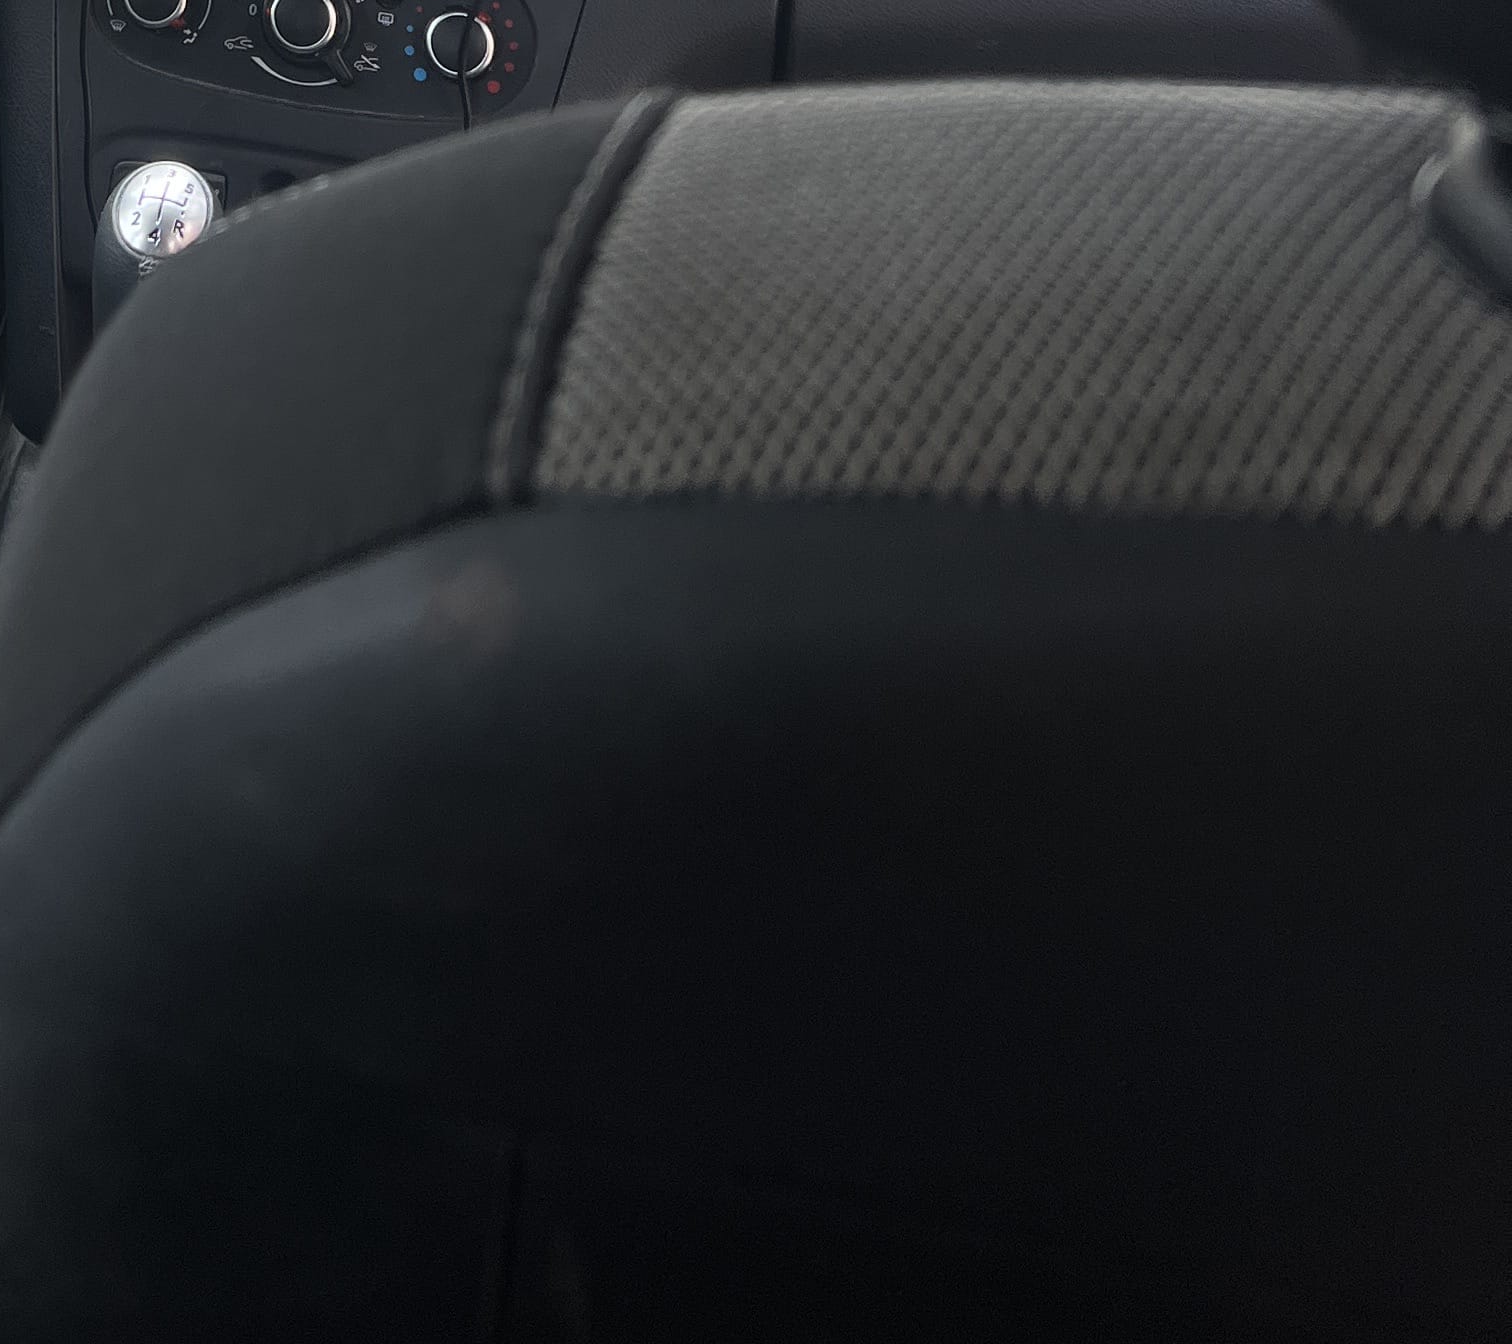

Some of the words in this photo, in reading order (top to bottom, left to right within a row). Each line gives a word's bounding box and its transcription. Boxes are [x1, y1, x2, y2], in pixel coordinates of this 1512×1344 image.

[184, 184, 194, 194] 5
[131, 212, 141, 225] 2
[148, 227, 161, 246] 4
[173, 220, 184, 239] R
